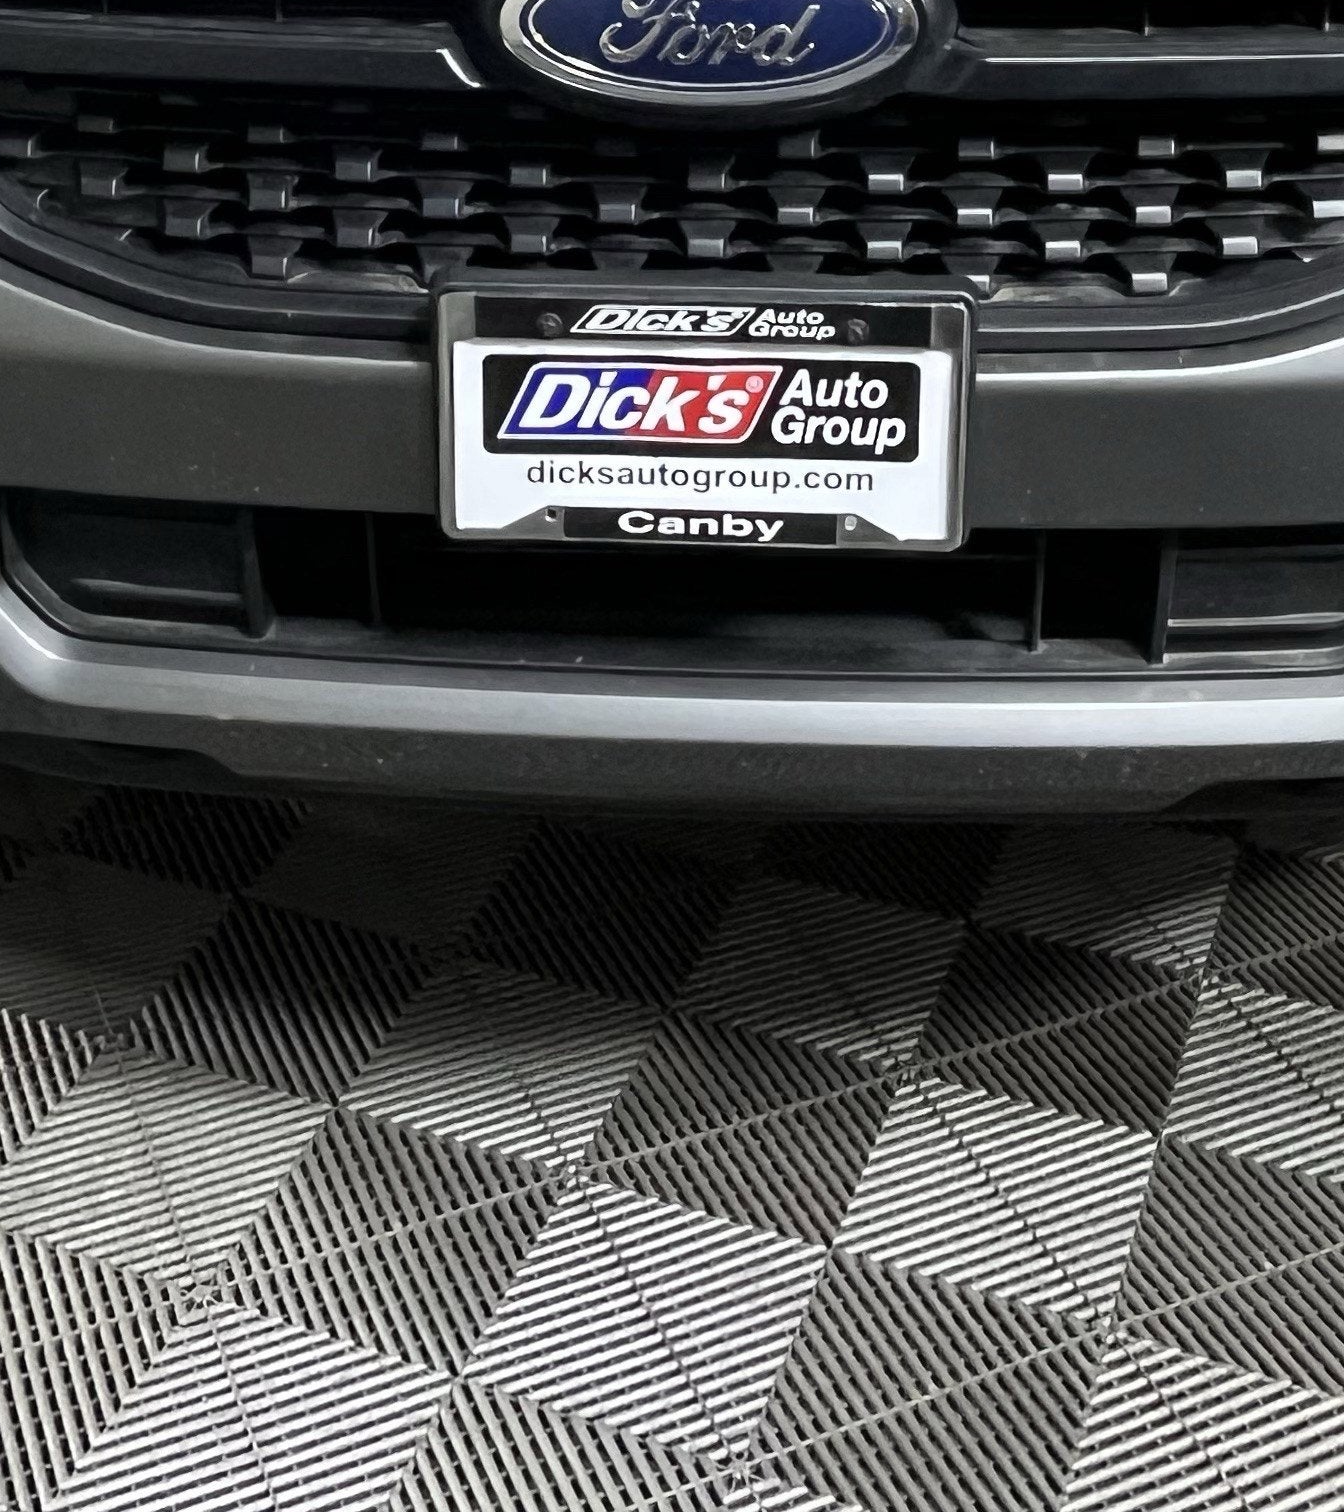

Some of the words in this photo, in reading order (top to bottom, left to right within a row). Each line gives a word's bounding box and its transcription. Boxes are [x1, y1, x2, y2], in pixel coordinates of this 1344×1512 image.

[585, 307, 734, 333] Dick's
[748, 322, 836, 341] Group
[757, 308, 825, 325] Auto
[518, 370, 748, 435] Dick's
[779, 368, 890, 410] Auto
[770, 405, 907, 455] Group
[527, 459, 874, 494] dicksautogroup.com
[617, 509, 784, 542] Canby
